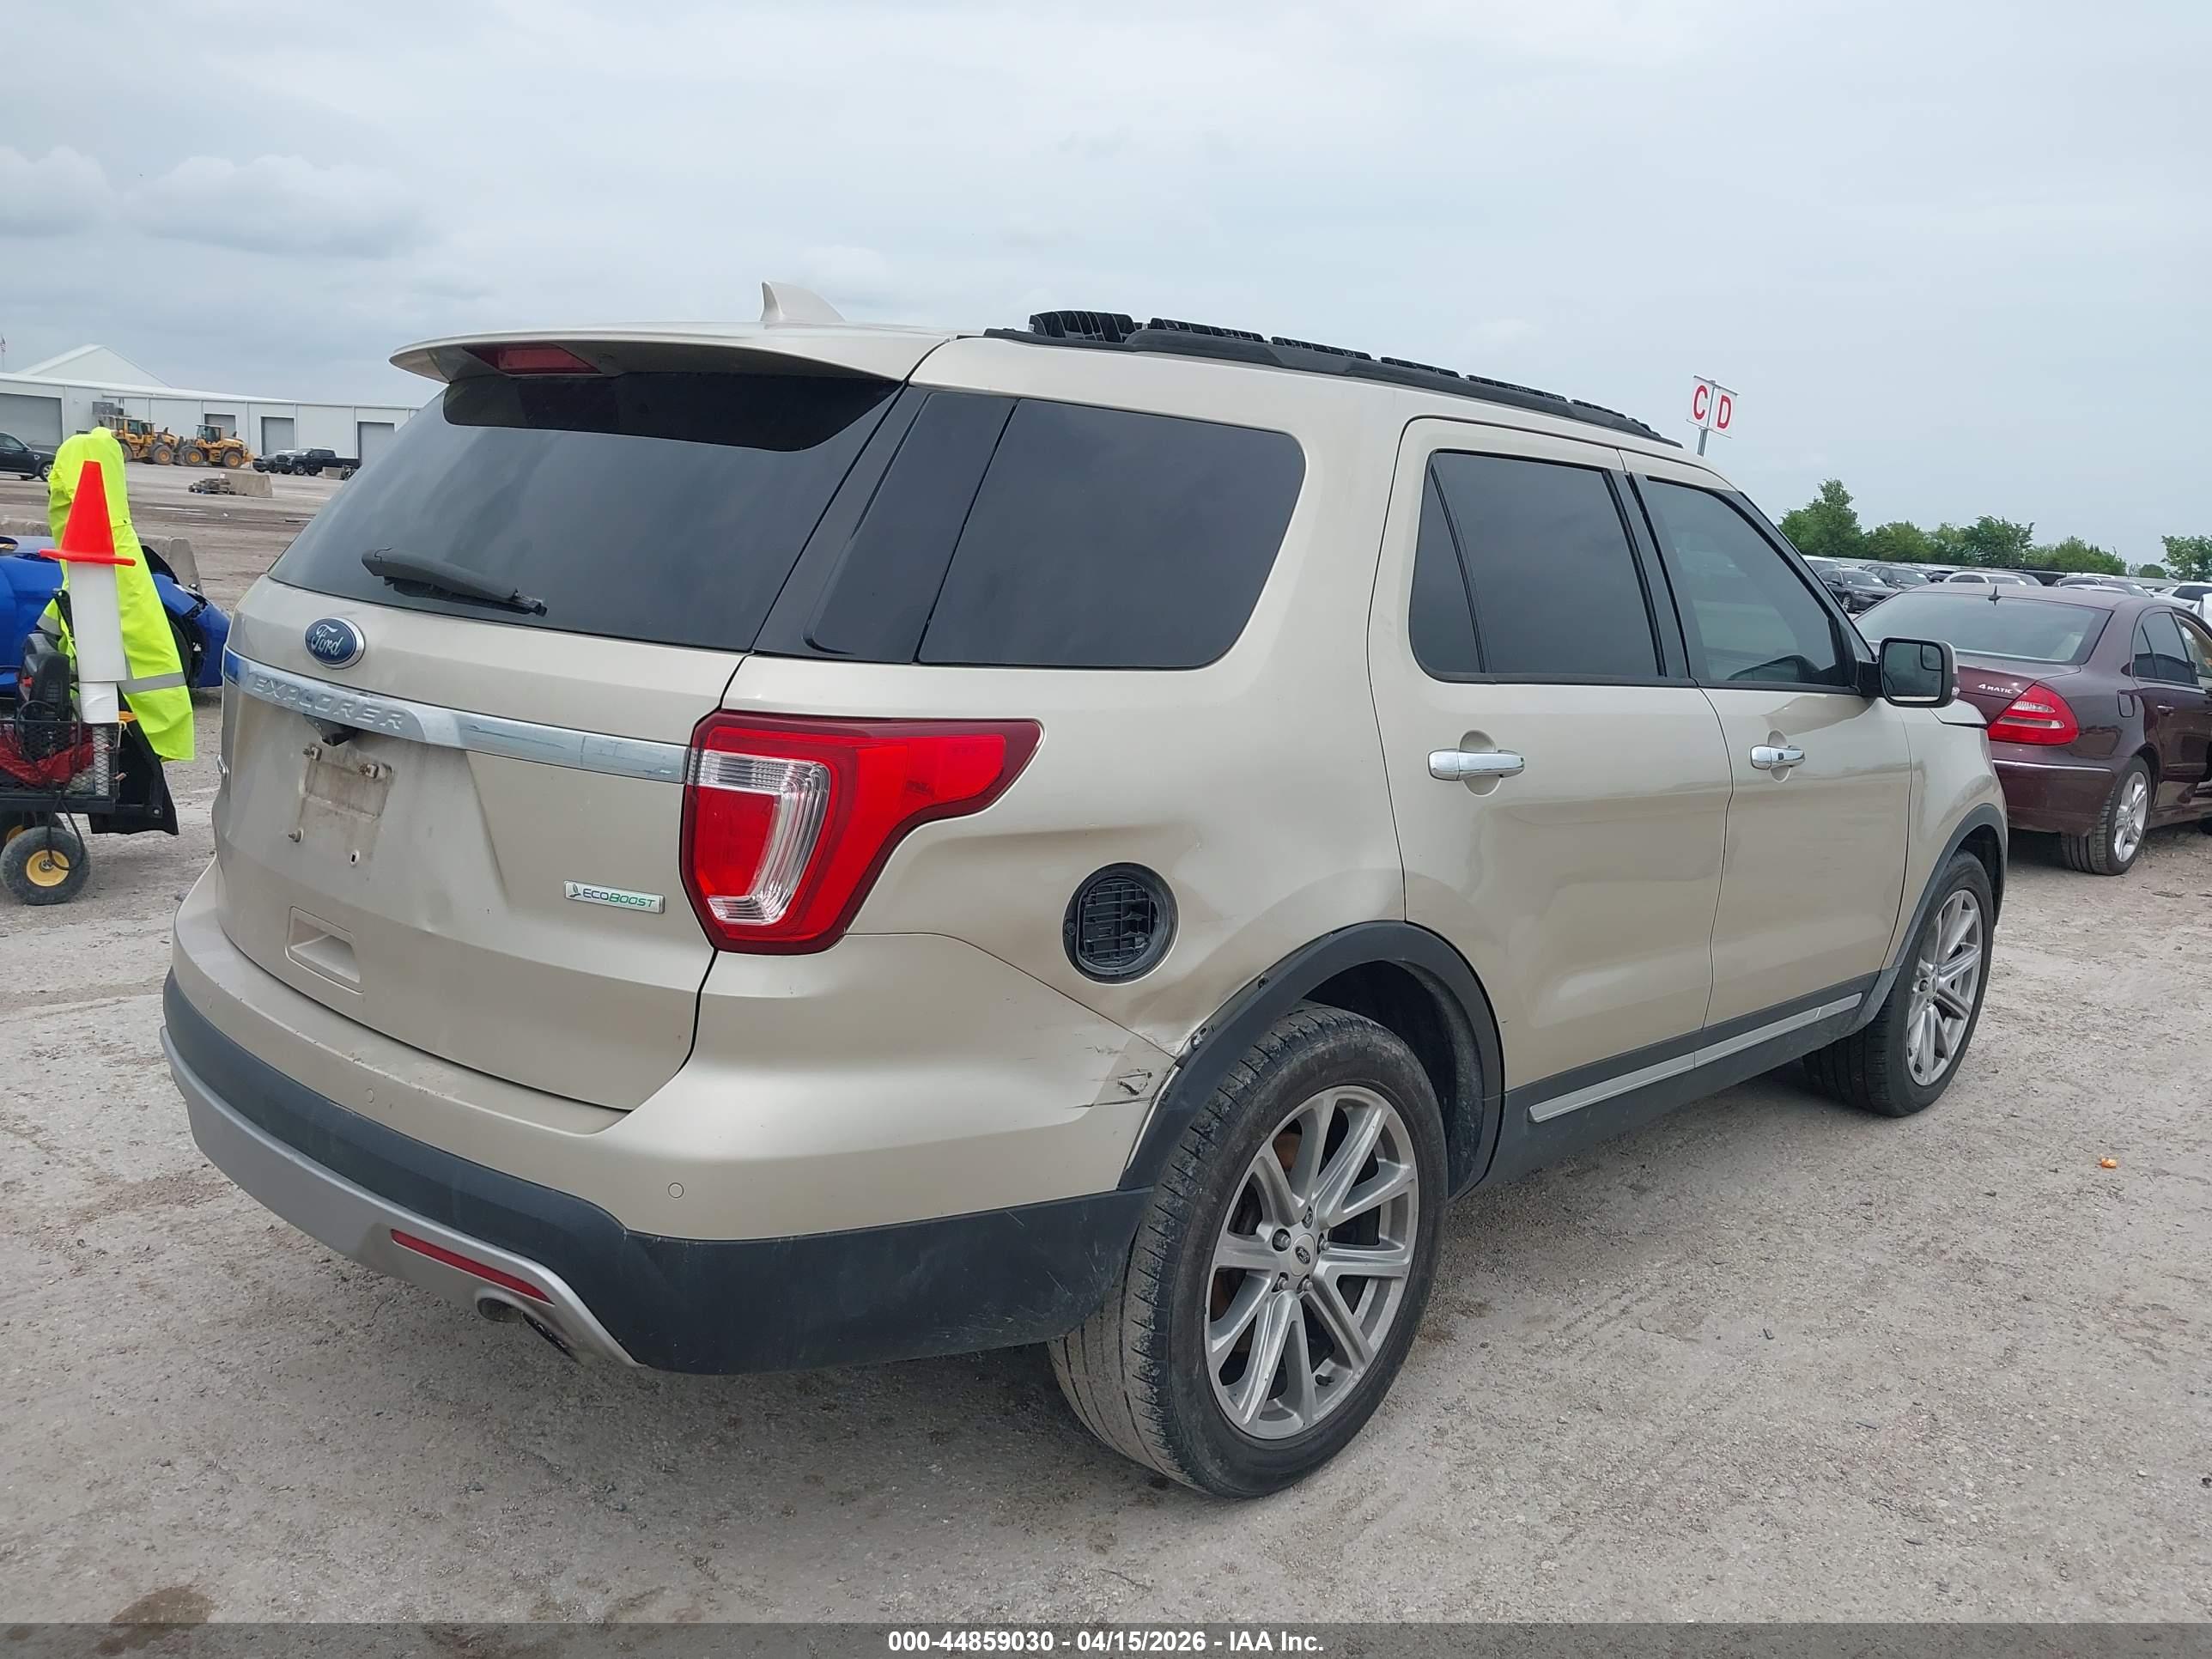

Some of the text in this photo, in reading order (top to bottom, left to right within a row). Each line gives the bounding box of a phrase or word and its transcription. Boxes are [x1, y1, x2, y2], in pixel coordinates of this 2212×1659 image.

[1693, 385, 1708, 420] C
[1717, 394, 1732, 429] D
[311, 623, 344, 656] Ford
[252, 677, 406, 731] EXPLORER
[582, 888, 656, 908] ECOBOOST
